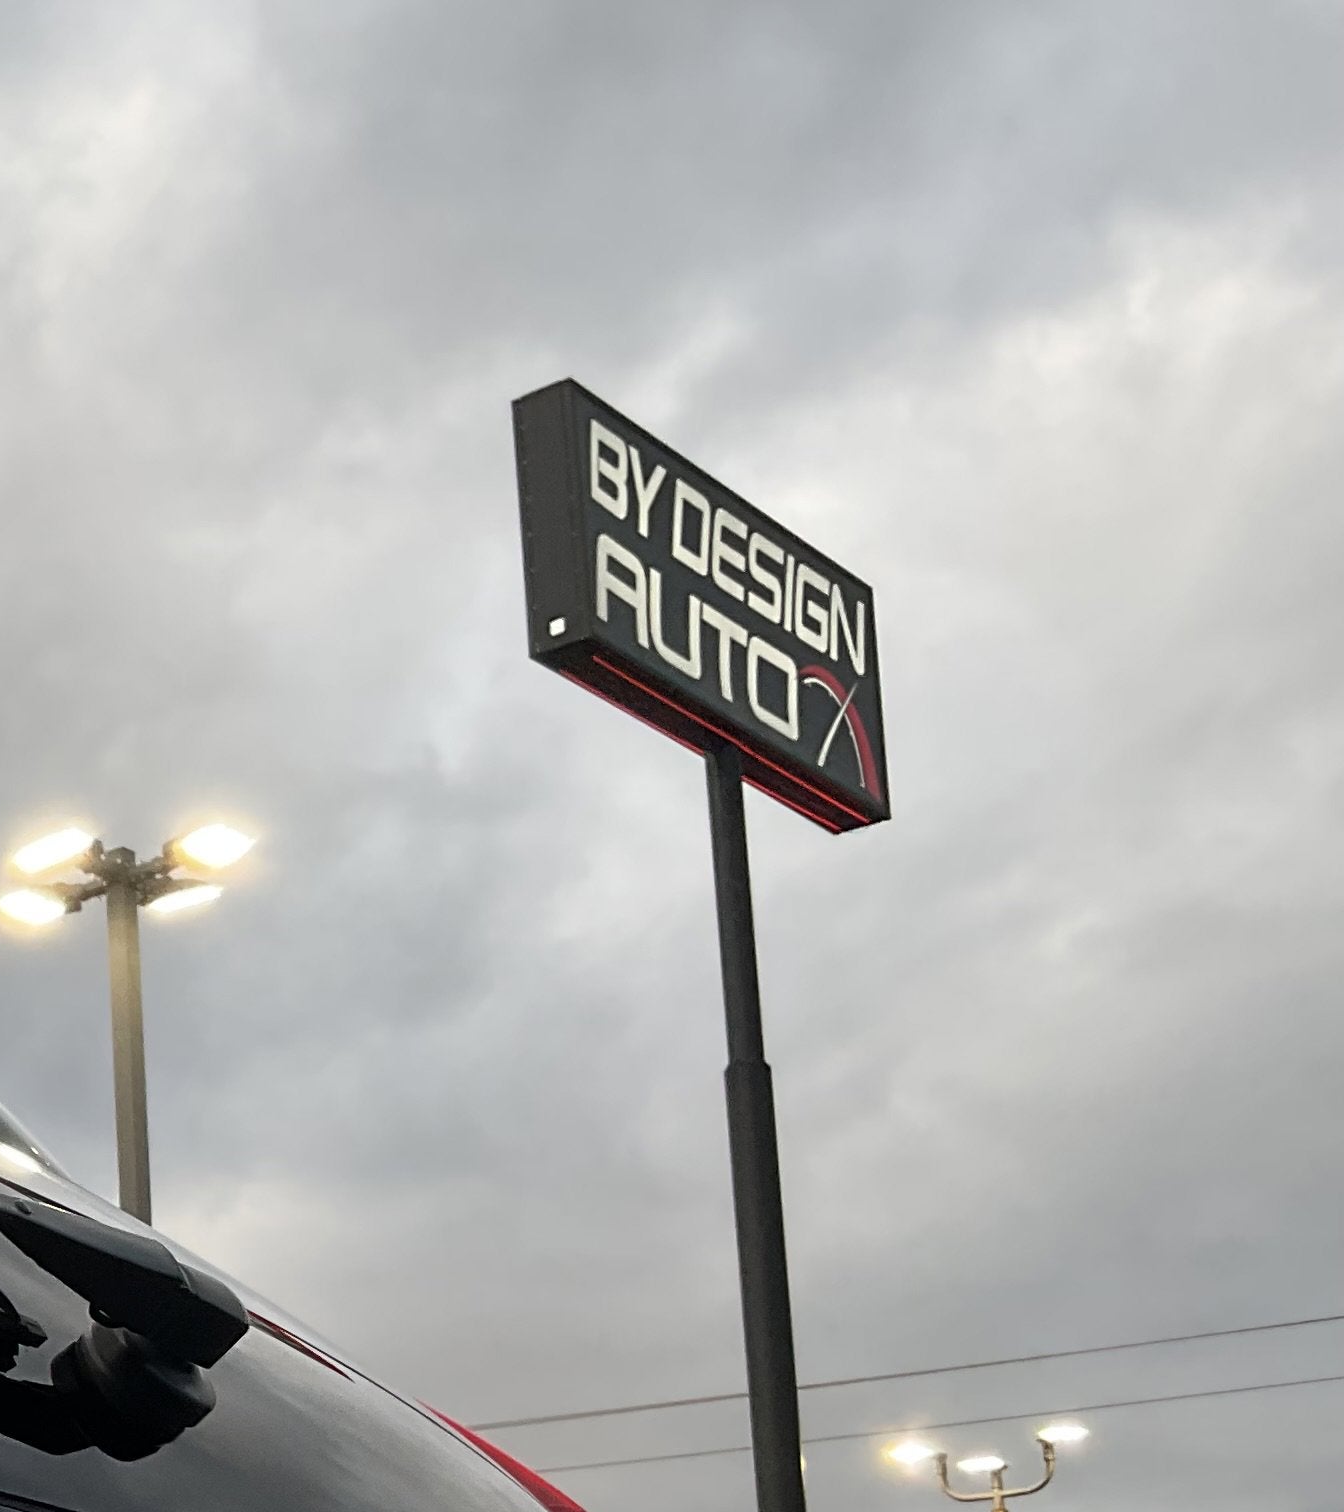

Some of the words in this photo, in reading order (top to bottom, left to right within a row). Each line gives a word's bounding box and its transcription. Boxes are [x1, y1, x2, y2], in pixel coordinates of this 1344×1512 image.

[590, 418, 667, 539] BY
[672, 477, 865, 676] DESIGN
[596, 533, 799, 742] AUTO
